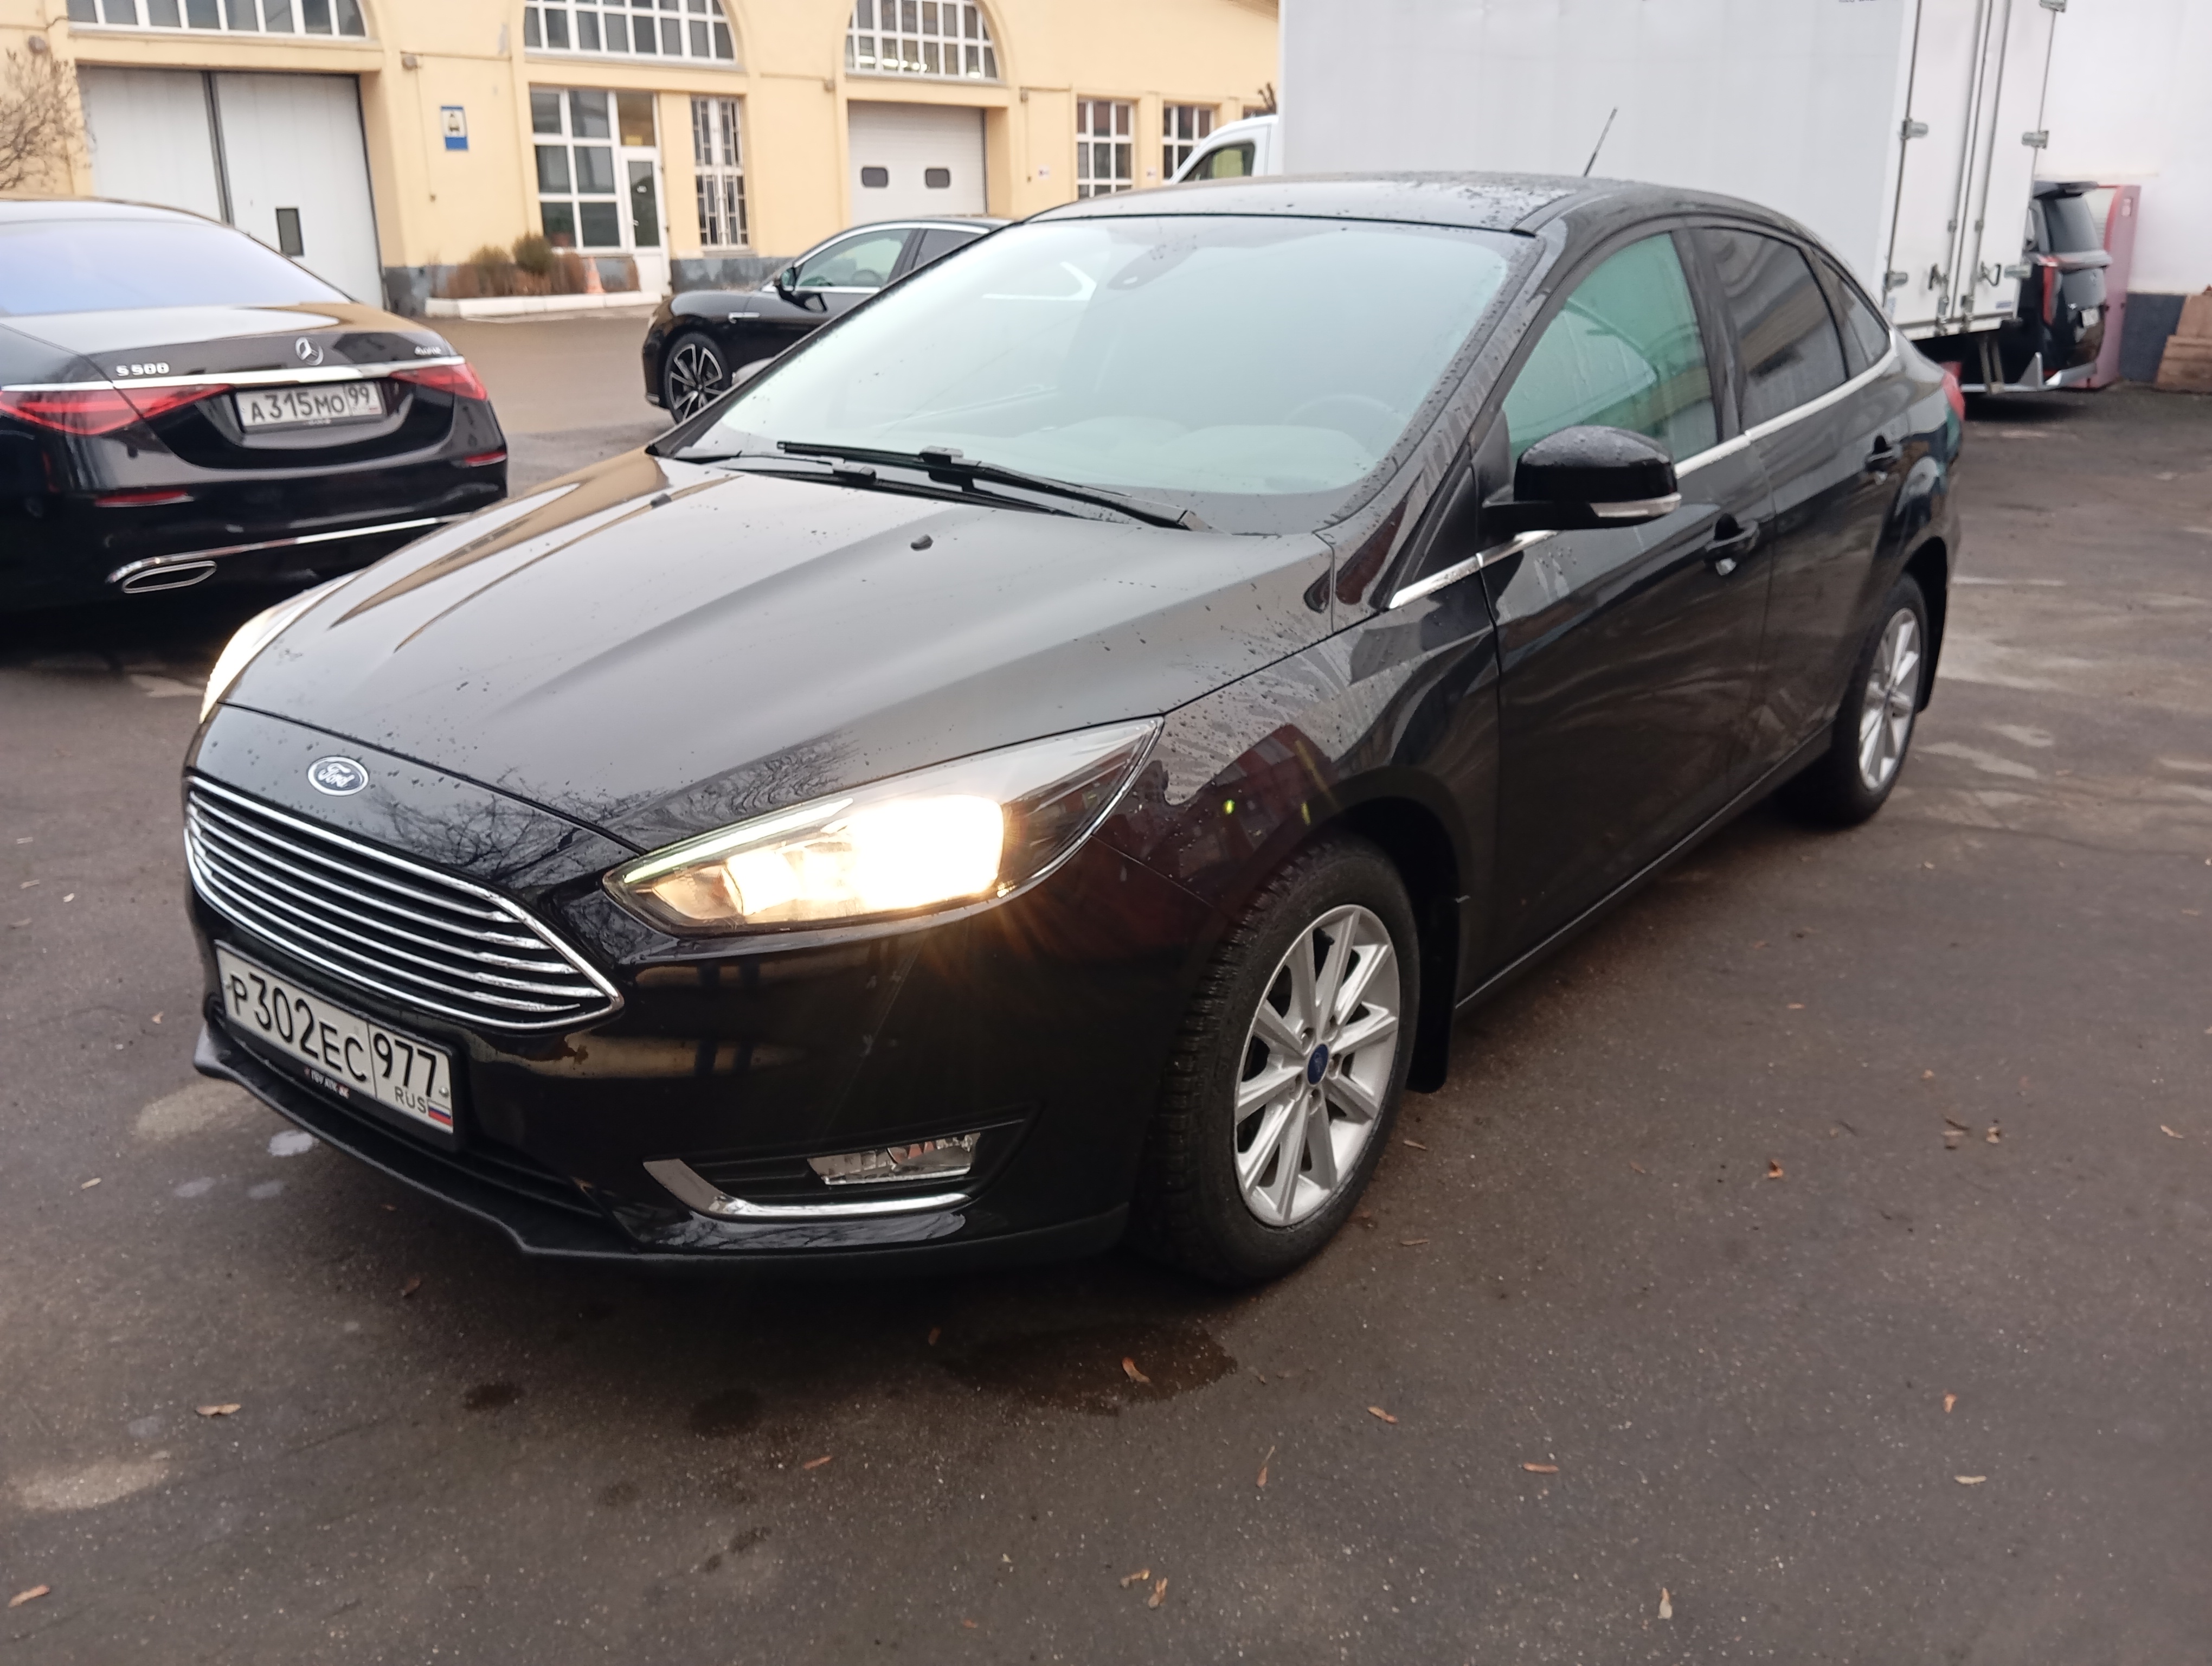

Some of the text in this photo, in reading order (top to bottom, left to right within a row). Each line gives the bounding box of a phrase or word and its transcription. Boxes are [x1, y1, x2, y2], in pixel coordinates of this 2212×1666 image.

[348, 386, 370, 405] 99
[229, 972, 437, 1097] Р302ЕС 977
[394, 1086, 427, 1114] RUS
